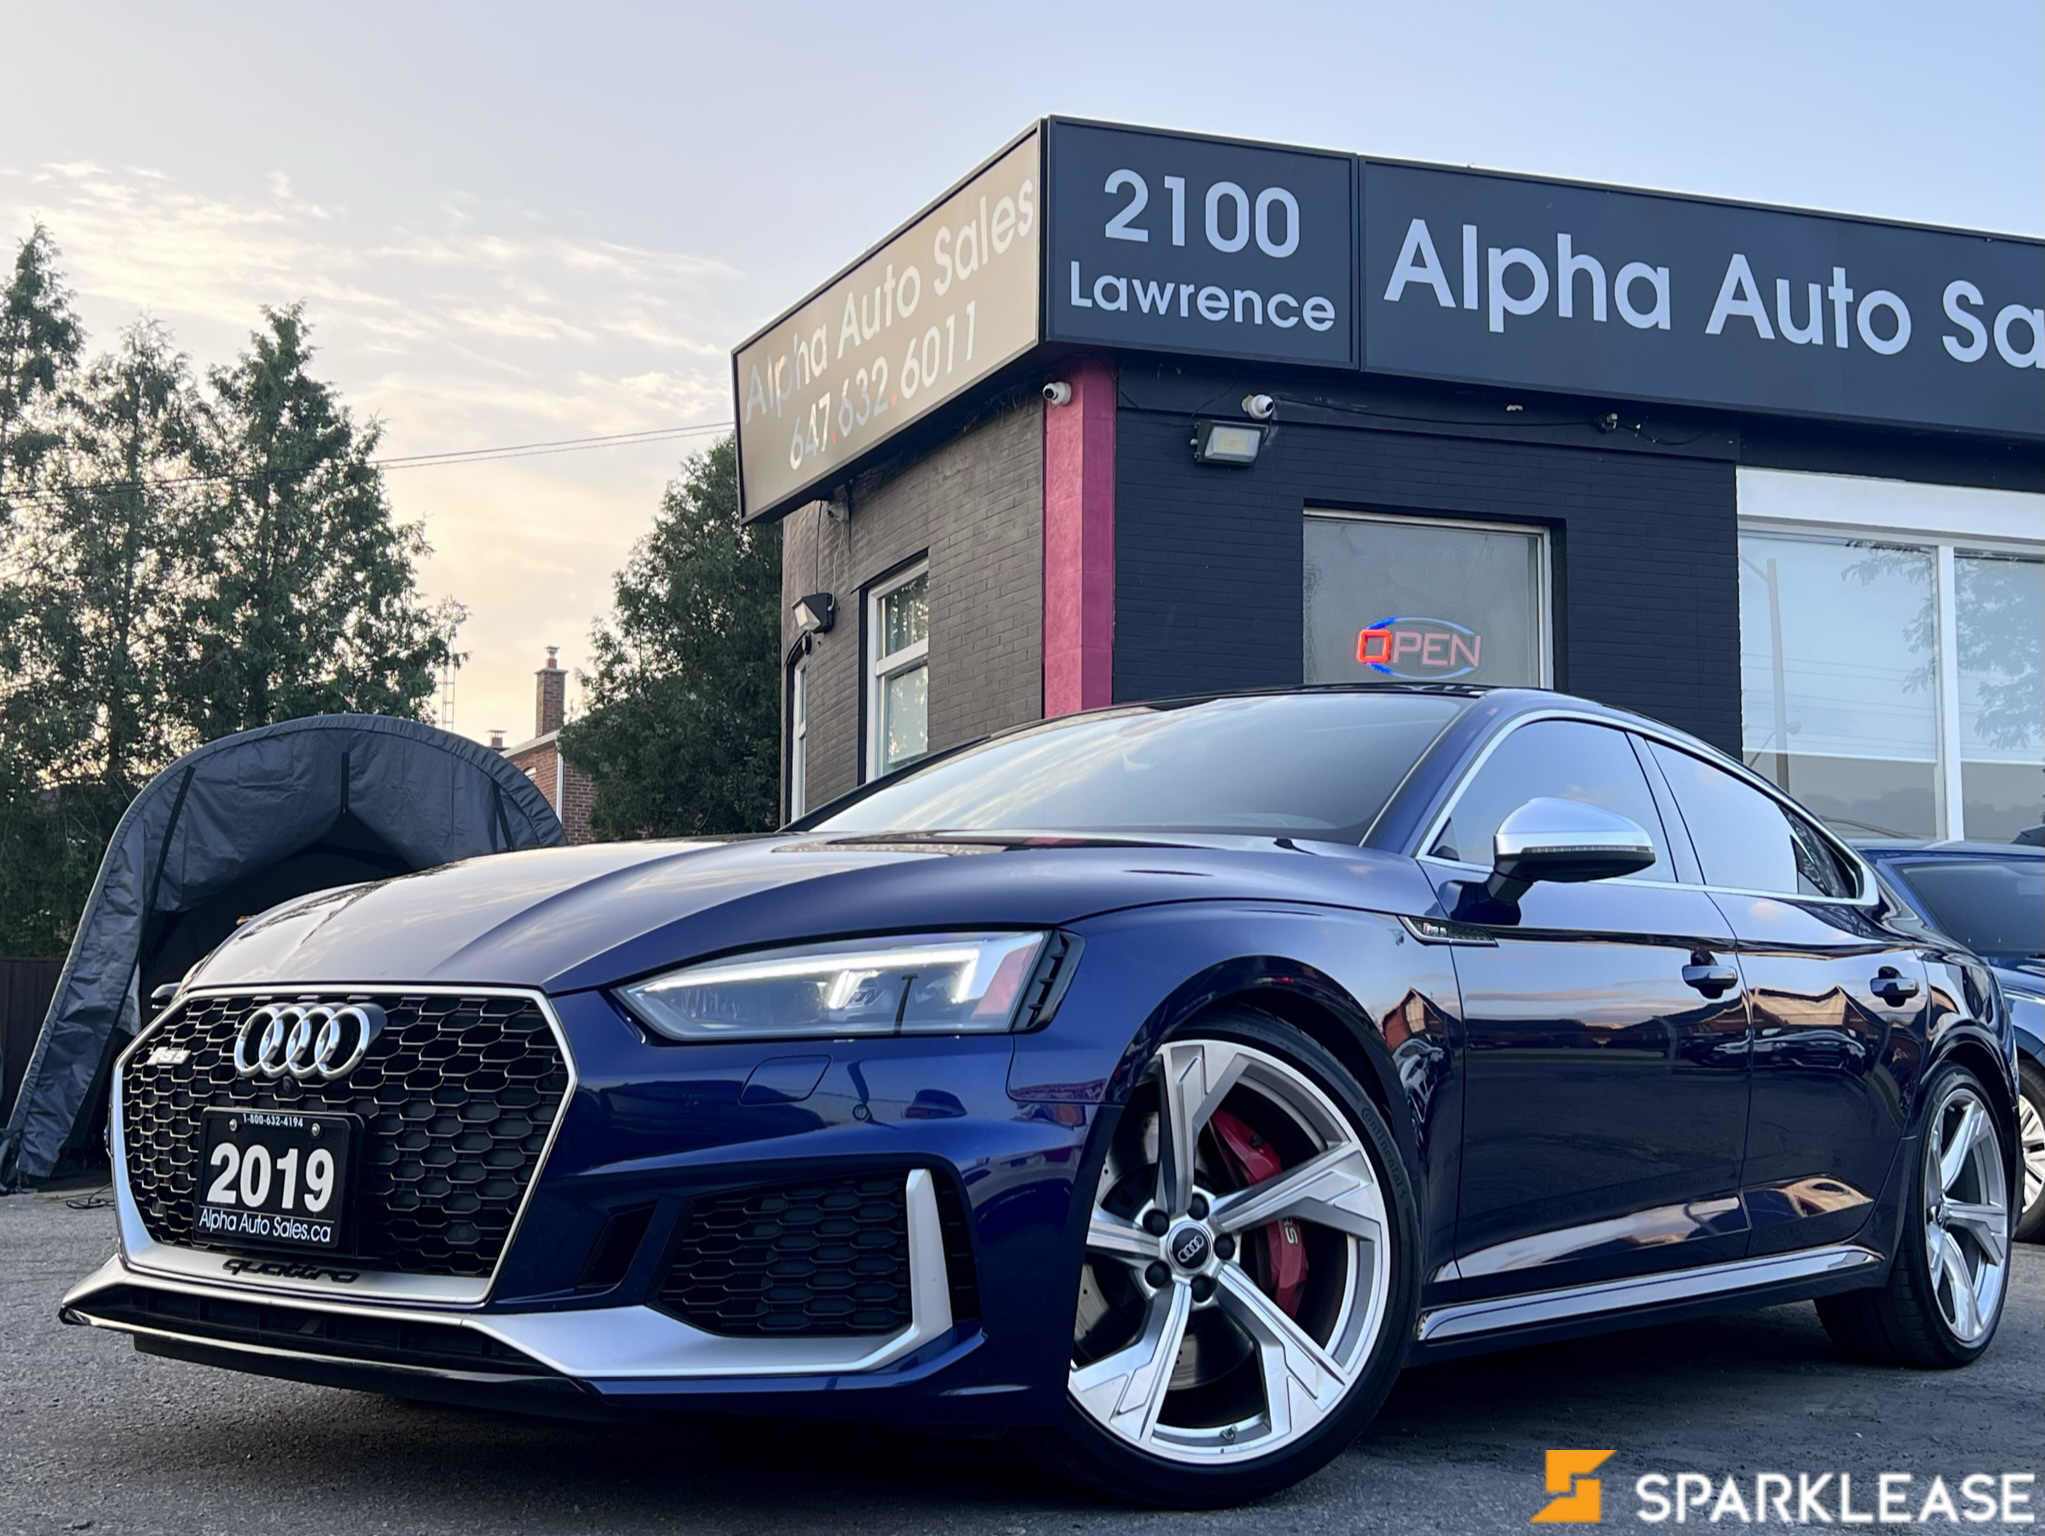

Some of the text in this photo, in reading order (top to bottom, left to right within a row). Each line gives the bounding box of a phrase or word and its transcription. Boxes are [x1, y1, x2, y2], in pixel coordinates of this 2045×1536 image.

[1104, 168, 1300, 258] 2100
[745, 178, 1033, 424] Alpha Auto Sales
[1070, 261, 1335, 332] Lawrence
[1384, 218, 2045, 369] Alpha Auto Sa
[1356, 628, 1481, 667] OPEN
[243, 1113, 304, 1128] 1-800-632-4194
[206, 1142, 335, 1212] 2019
[199, 1208, 331, 1243] Alpha Auto Sales.ca
[222, 1258, 360, 1284] quattro
